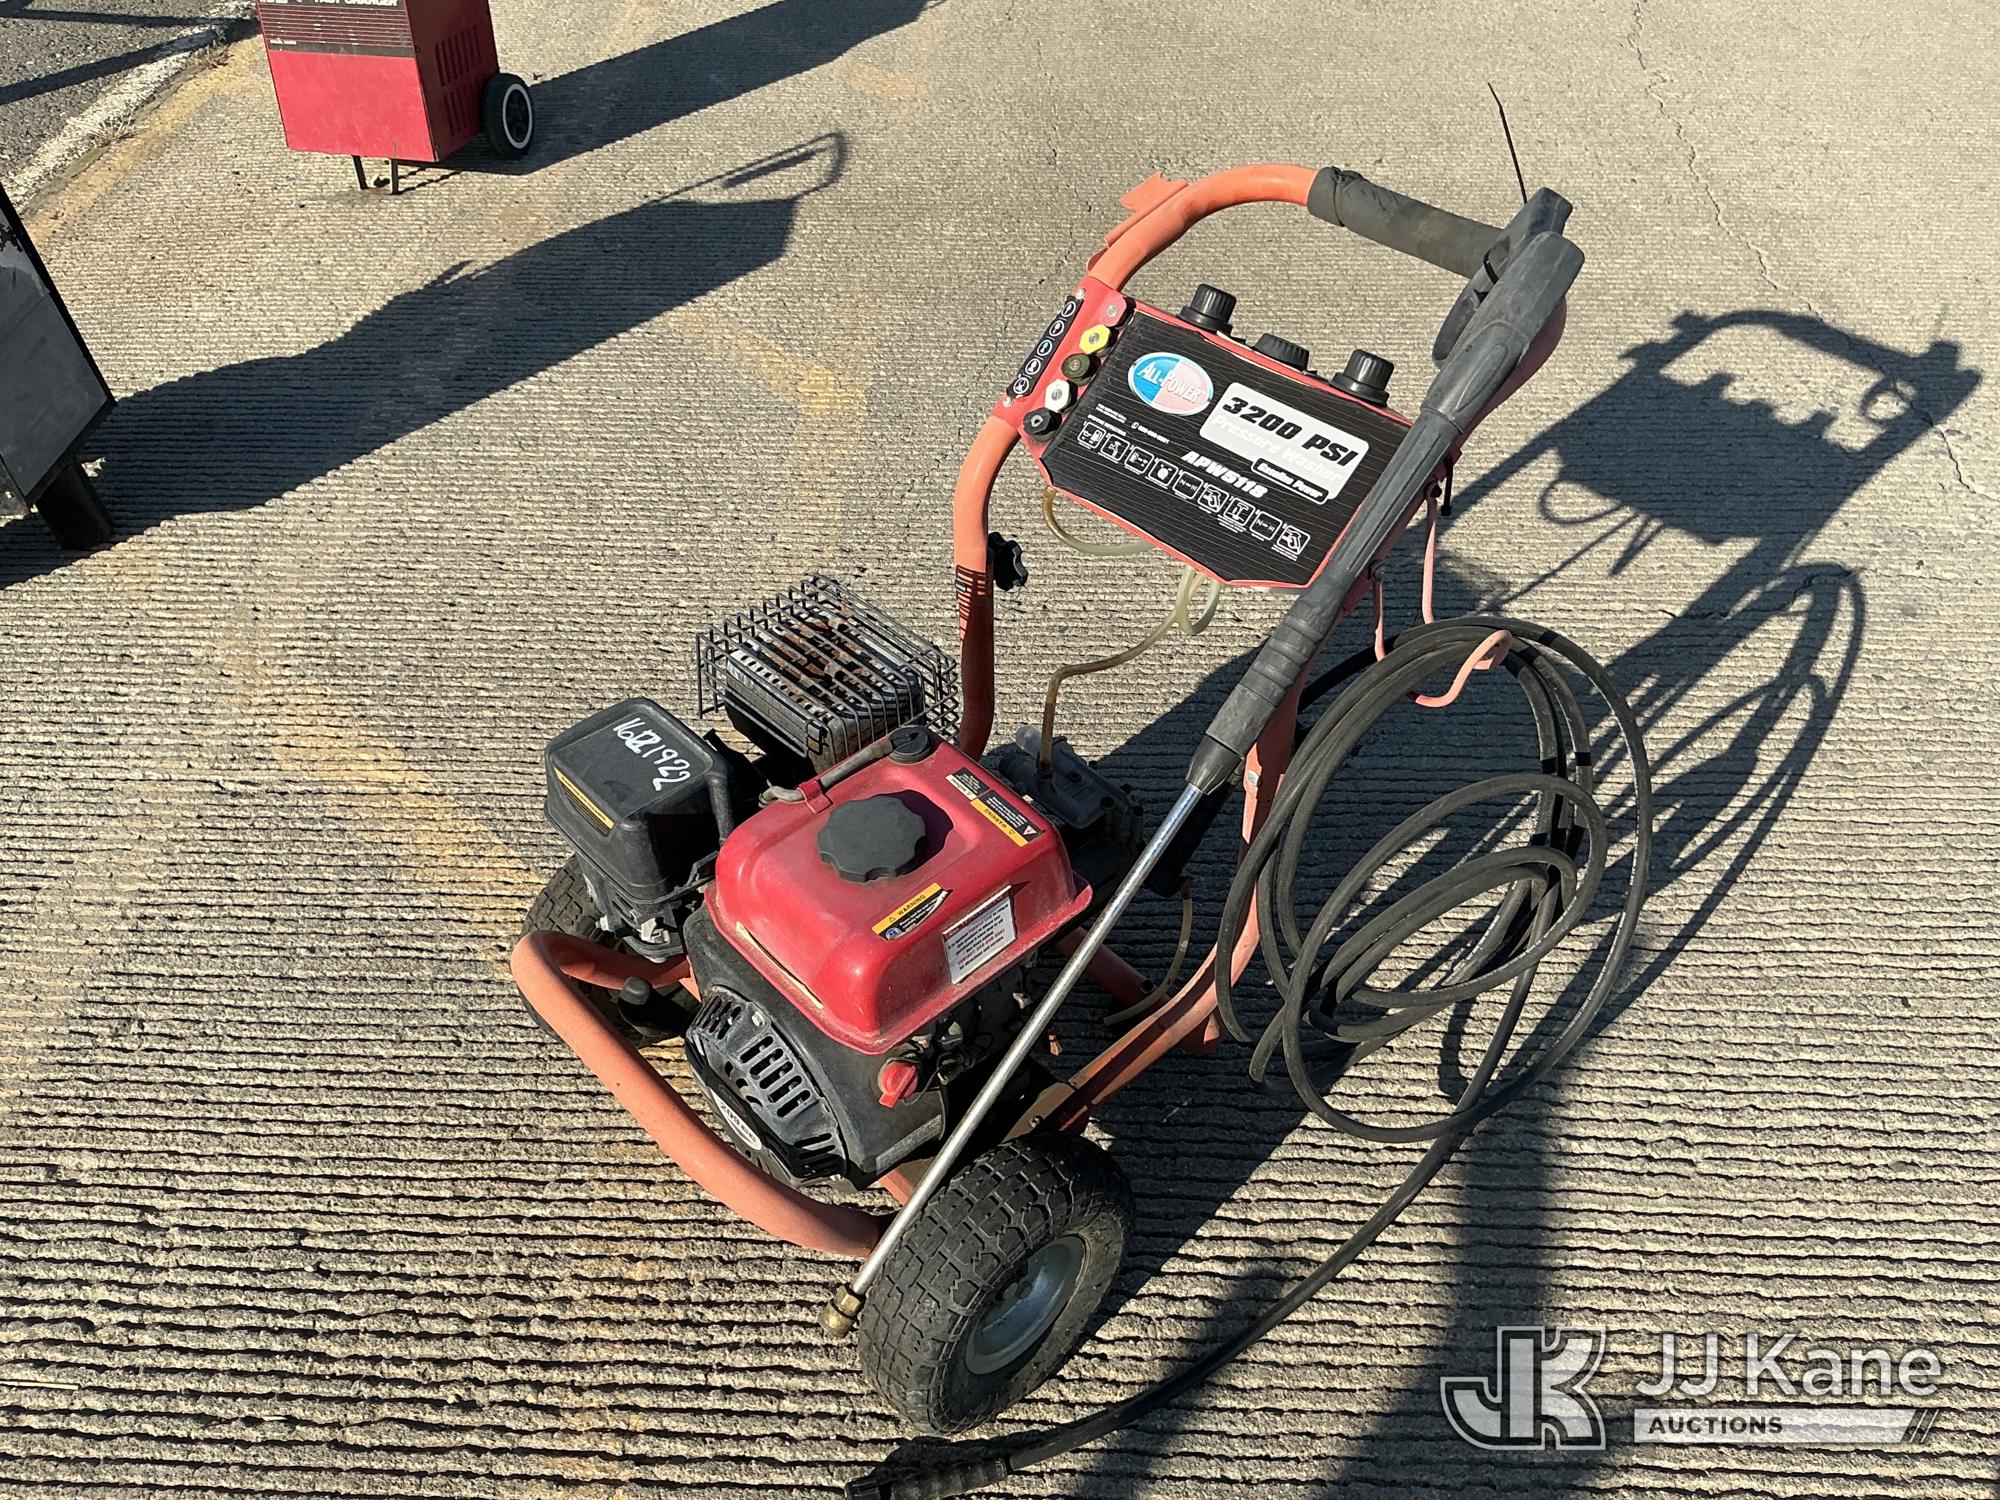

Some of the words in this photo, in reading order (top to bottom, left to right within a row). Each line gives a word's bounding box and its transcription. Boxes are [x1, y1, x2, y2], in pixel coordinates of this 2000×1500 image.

[1222, 397, 1303, 440] 3200
[1301, 433, 1359, 467] PSI
[1180, 450, 1269, 499] APW5118
[1256, 461, 1295, 486] Gasoline
[1292, 477, 1324, 499] Power
[897, 894, 926, 916] WARNING
